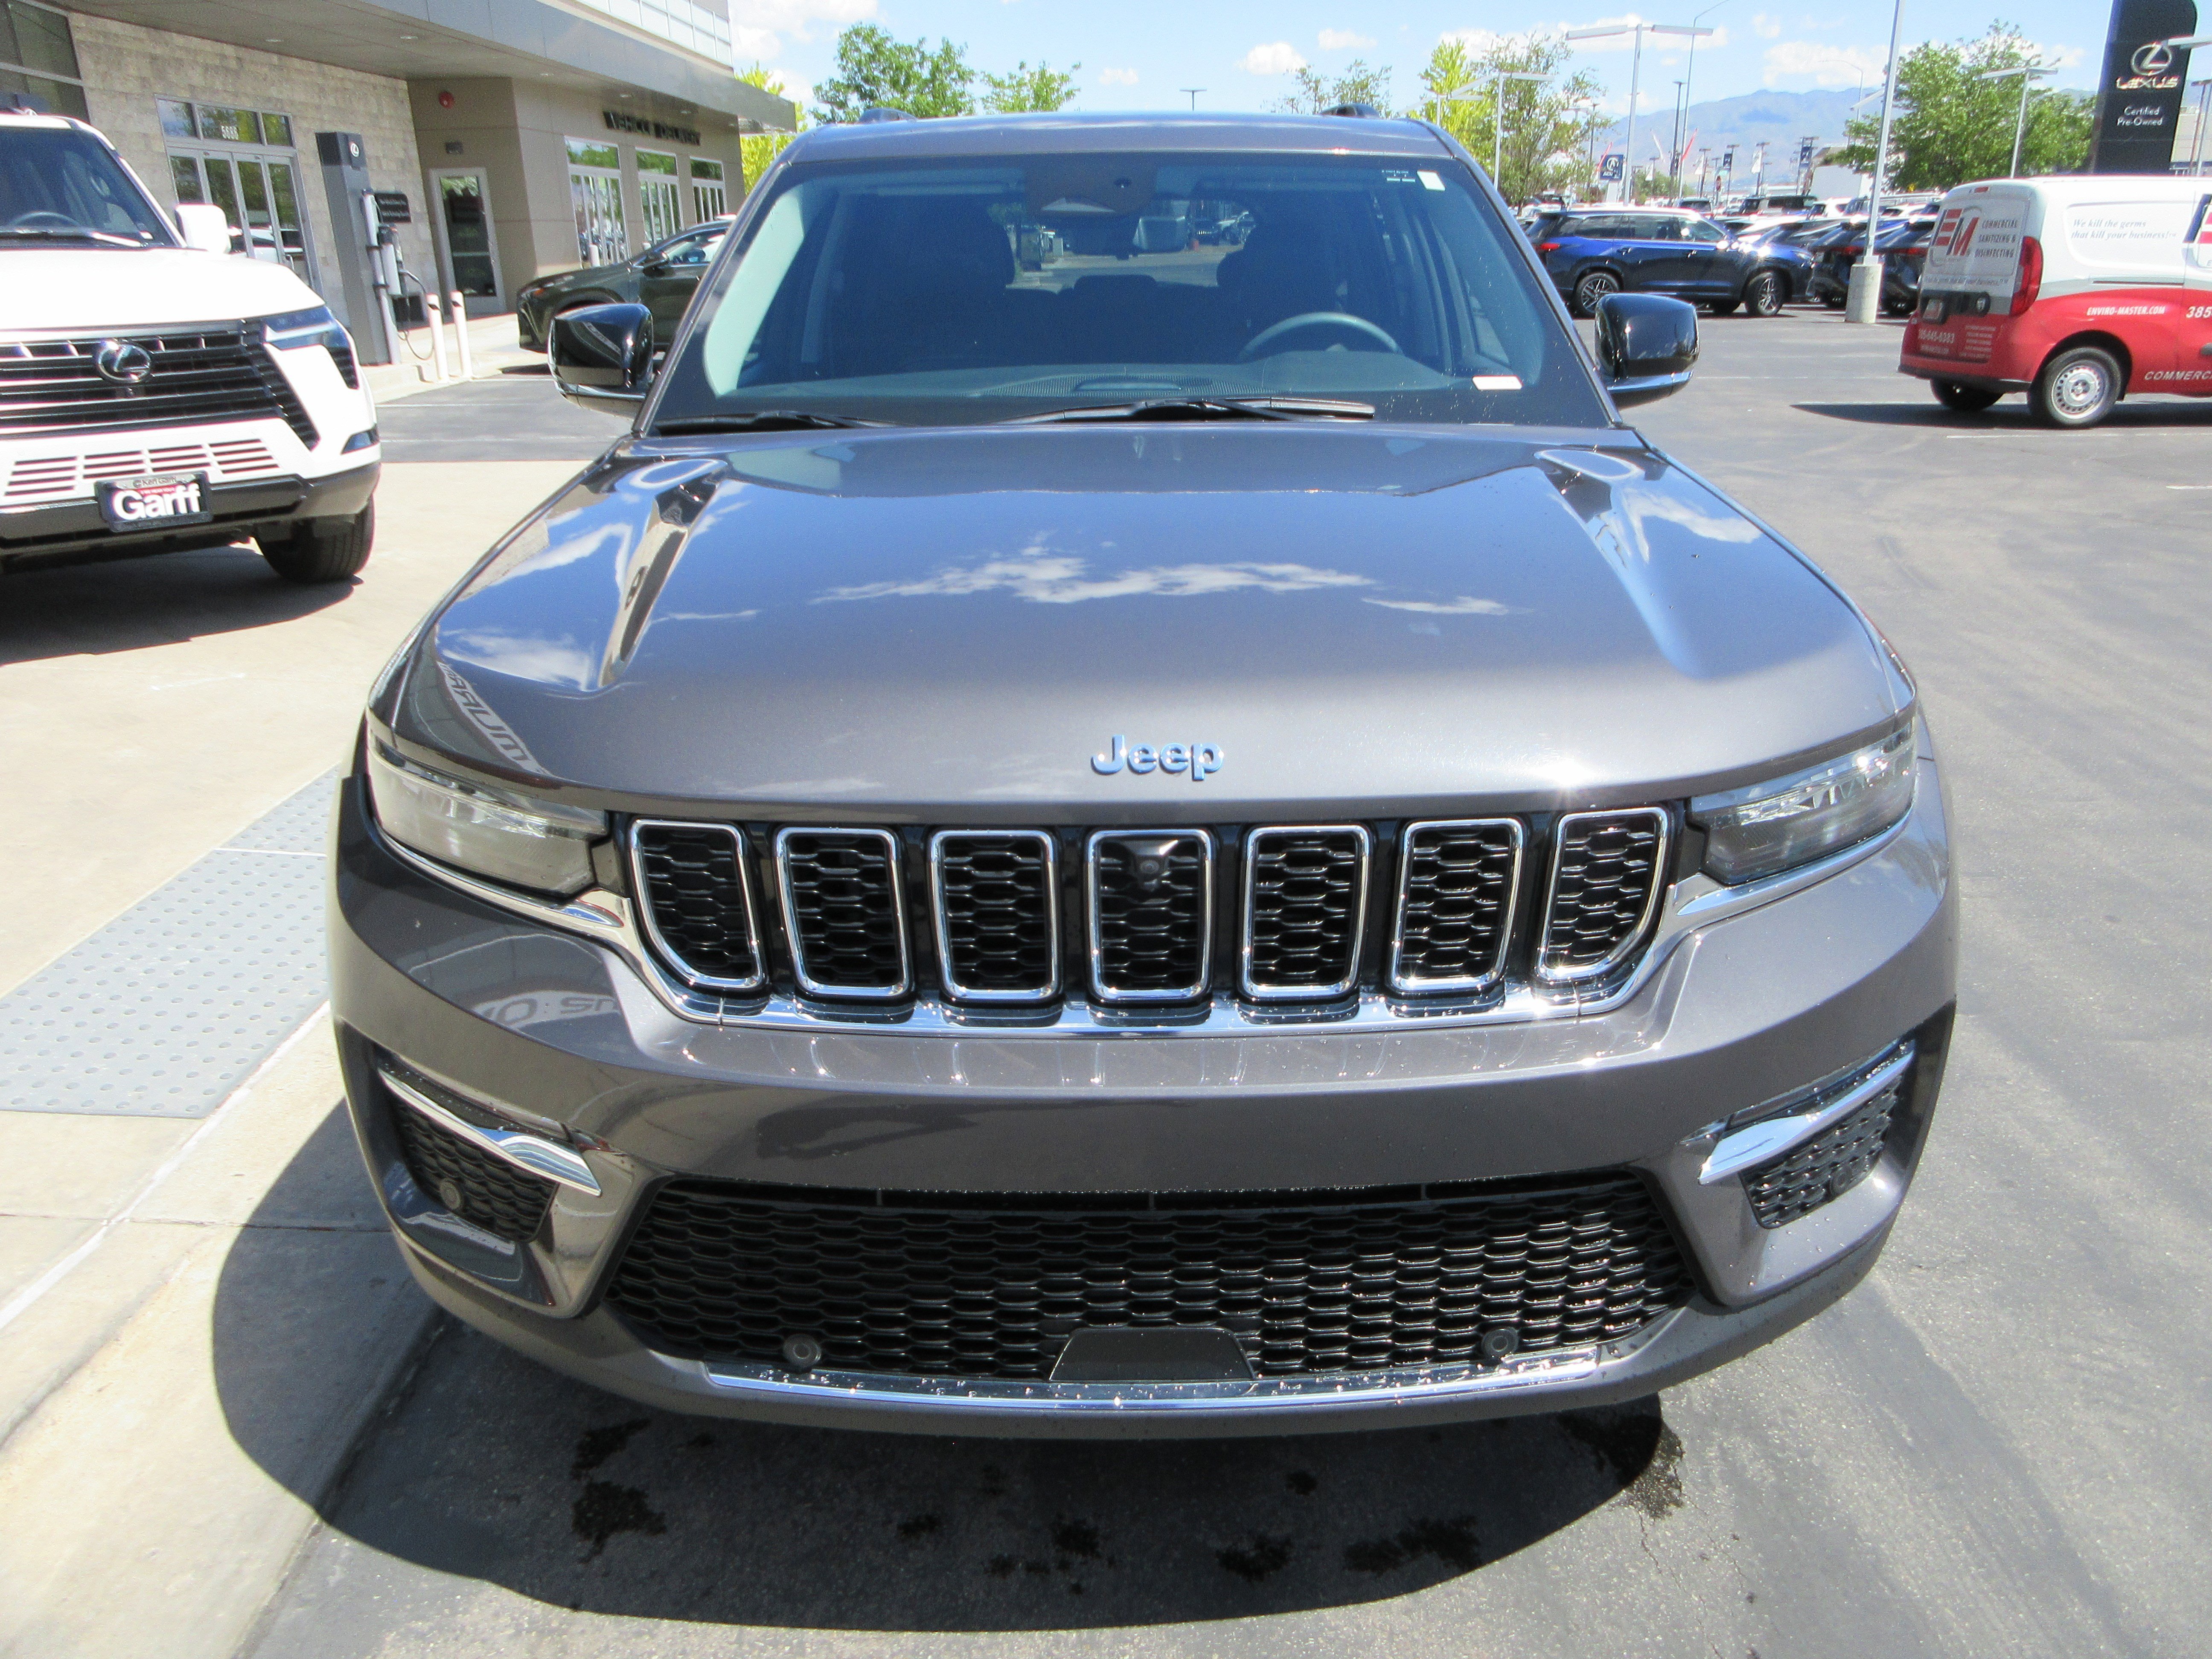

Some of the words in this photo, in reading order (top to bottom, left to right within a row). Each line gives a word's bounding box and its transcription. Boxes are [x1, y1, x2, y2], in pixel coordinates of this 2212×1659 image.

[2116, 76, 2180, 89] LEXUS
[2124, 106, 2161, 116] Certified
[2116, 116, 2164, 126] Pre-Owned
[2073, 218, 2086, 227] We
[2088, 219, 2103, 227] kill
[2119, 221, 2146, 229] germs
[2071, 230, 2089, 239] that
[2090, 230, 2106, 239] kill
[2086, 306, 2166, 316] ENVIRO-MASTER.COM
[2186, 306, 2212, 319] 385
[113, 482, 201, 520] Garff
[1091, 734, 1224, 781] Jeep
